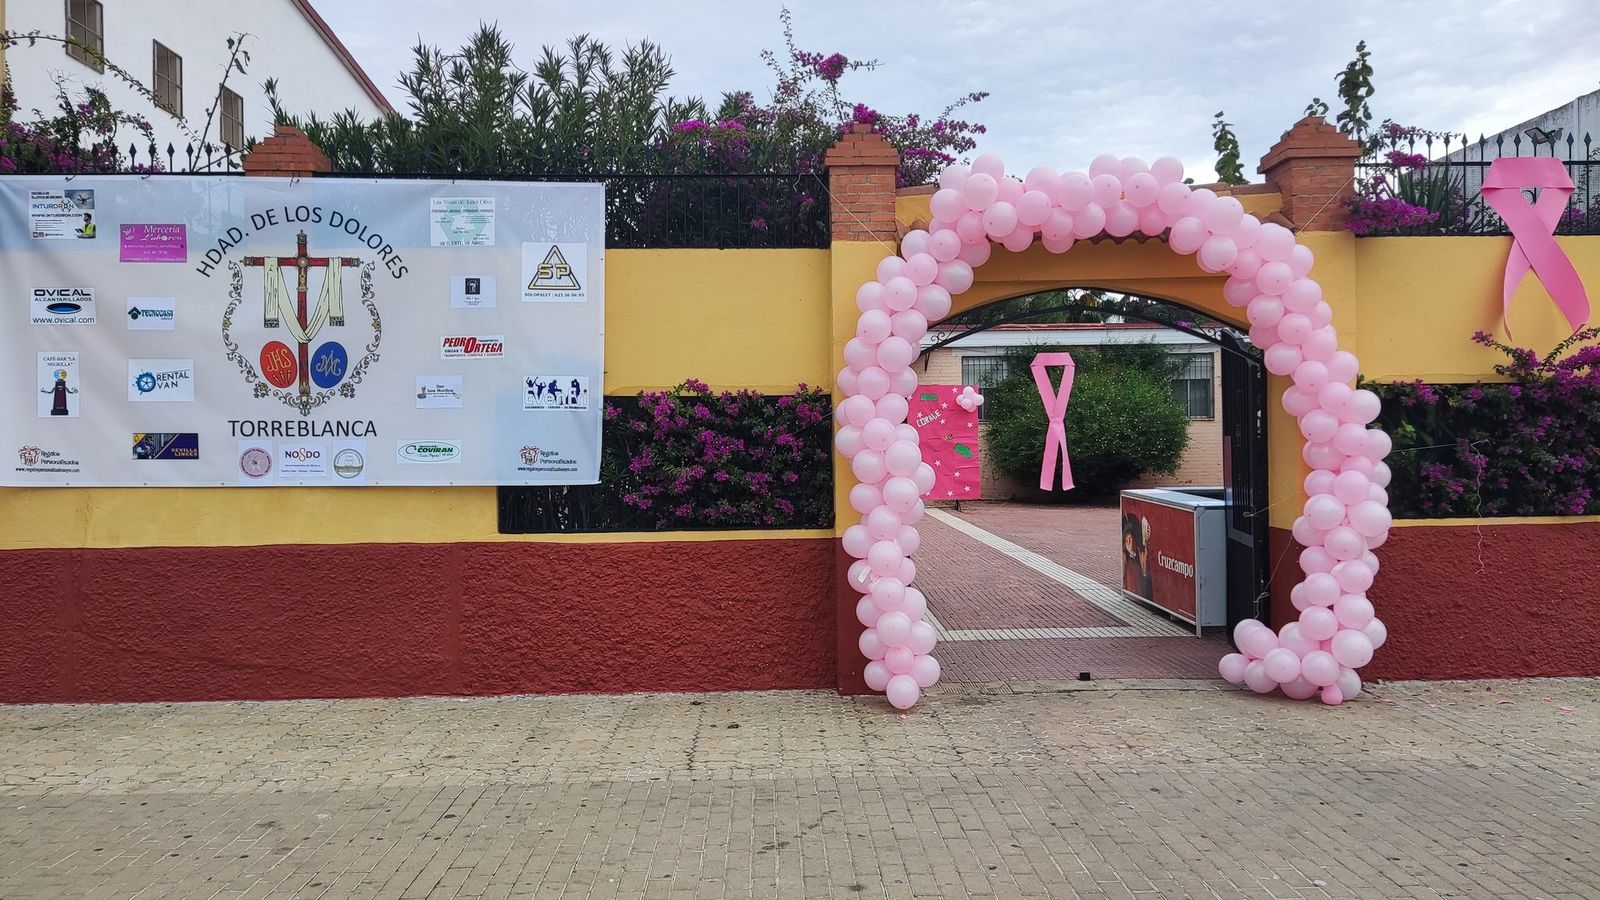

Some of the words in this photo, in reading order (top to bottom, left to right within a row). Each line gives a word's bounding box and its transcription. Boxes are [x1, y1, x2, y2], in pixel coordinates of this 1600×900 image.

[196, 227, 249, 278] HDAD.
[250, 208, 279, 231] DE
[284, 205, 322, 224] LOS
[329, 210, 409, 280] DOLORES
[537, 262, 571, 280] SP
[33, 288, 92, 296] OVICAL
[141, 309, 174, 317] TECNOCASA
[32, 316, 95, 324] www.ovical.com
[156, 371, 189, 382] RENTAL
[157, 380, 178, 389] VAN
[228, 420, 378, 438] TORREBLANCA
[1158, 550, 1194, 578] Cruzcampo
